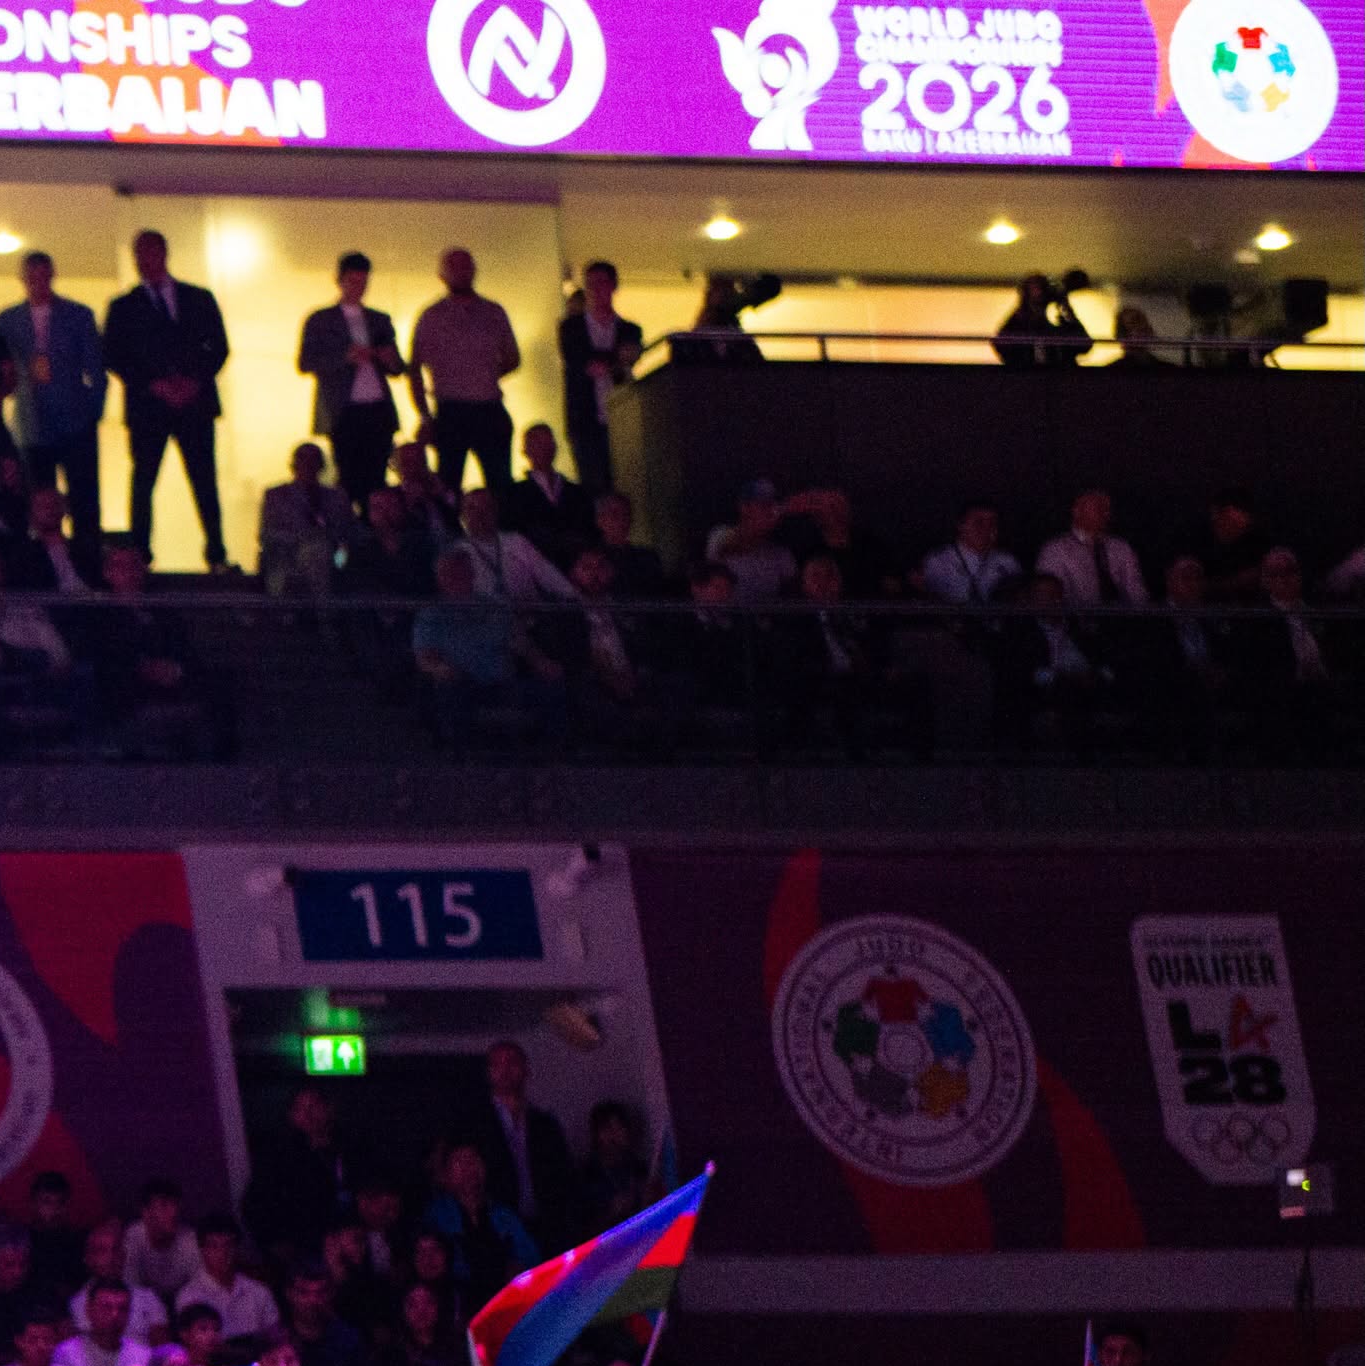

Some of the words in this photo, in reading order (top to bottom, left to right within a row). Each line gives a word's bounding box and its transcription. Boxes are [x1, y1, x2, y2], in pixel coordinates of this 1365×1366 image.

[858, 62, 1070, 134] 2026
[350, 882, 483, 947] 115
[1147, 951, 1279, 991] QUALIFIER
[1179, 1054, 1287, 1106] 28
